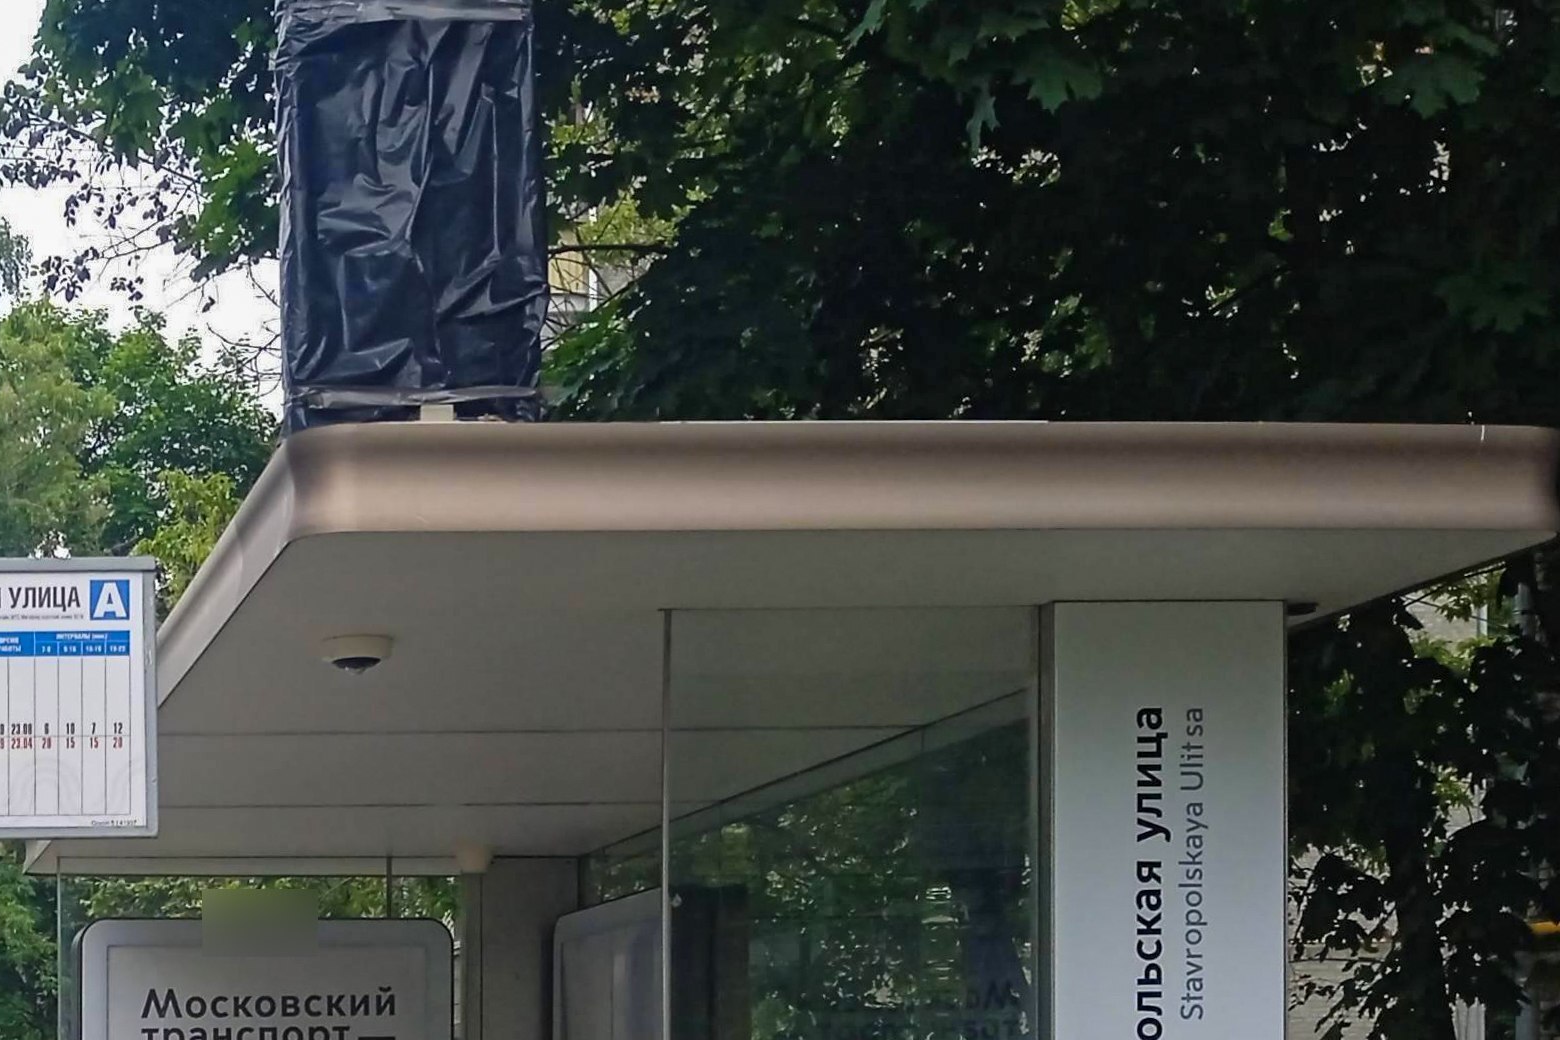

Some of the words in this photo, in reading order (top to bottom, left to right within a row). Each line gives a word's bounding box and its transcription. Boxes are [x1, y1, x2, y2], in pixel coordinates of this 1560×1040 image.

[8, 585, 81, 612] УЛИЦА
[66, 723, 75, 734] 10
[91, 723, 96, 734] 7
[113, 723, 123, 734] 12
[66, 737, 75, 748] 15
[90, 737, 99, 748] 15
[113, 737, 123, 748] 20
[1179, 707, 1205, 791] Ulitsa
[1136, 706, 1172, 843] улица
[1177, 801, 1209, 1021] Stavropolskaya
[141, 986, 396, 1019] Московский
